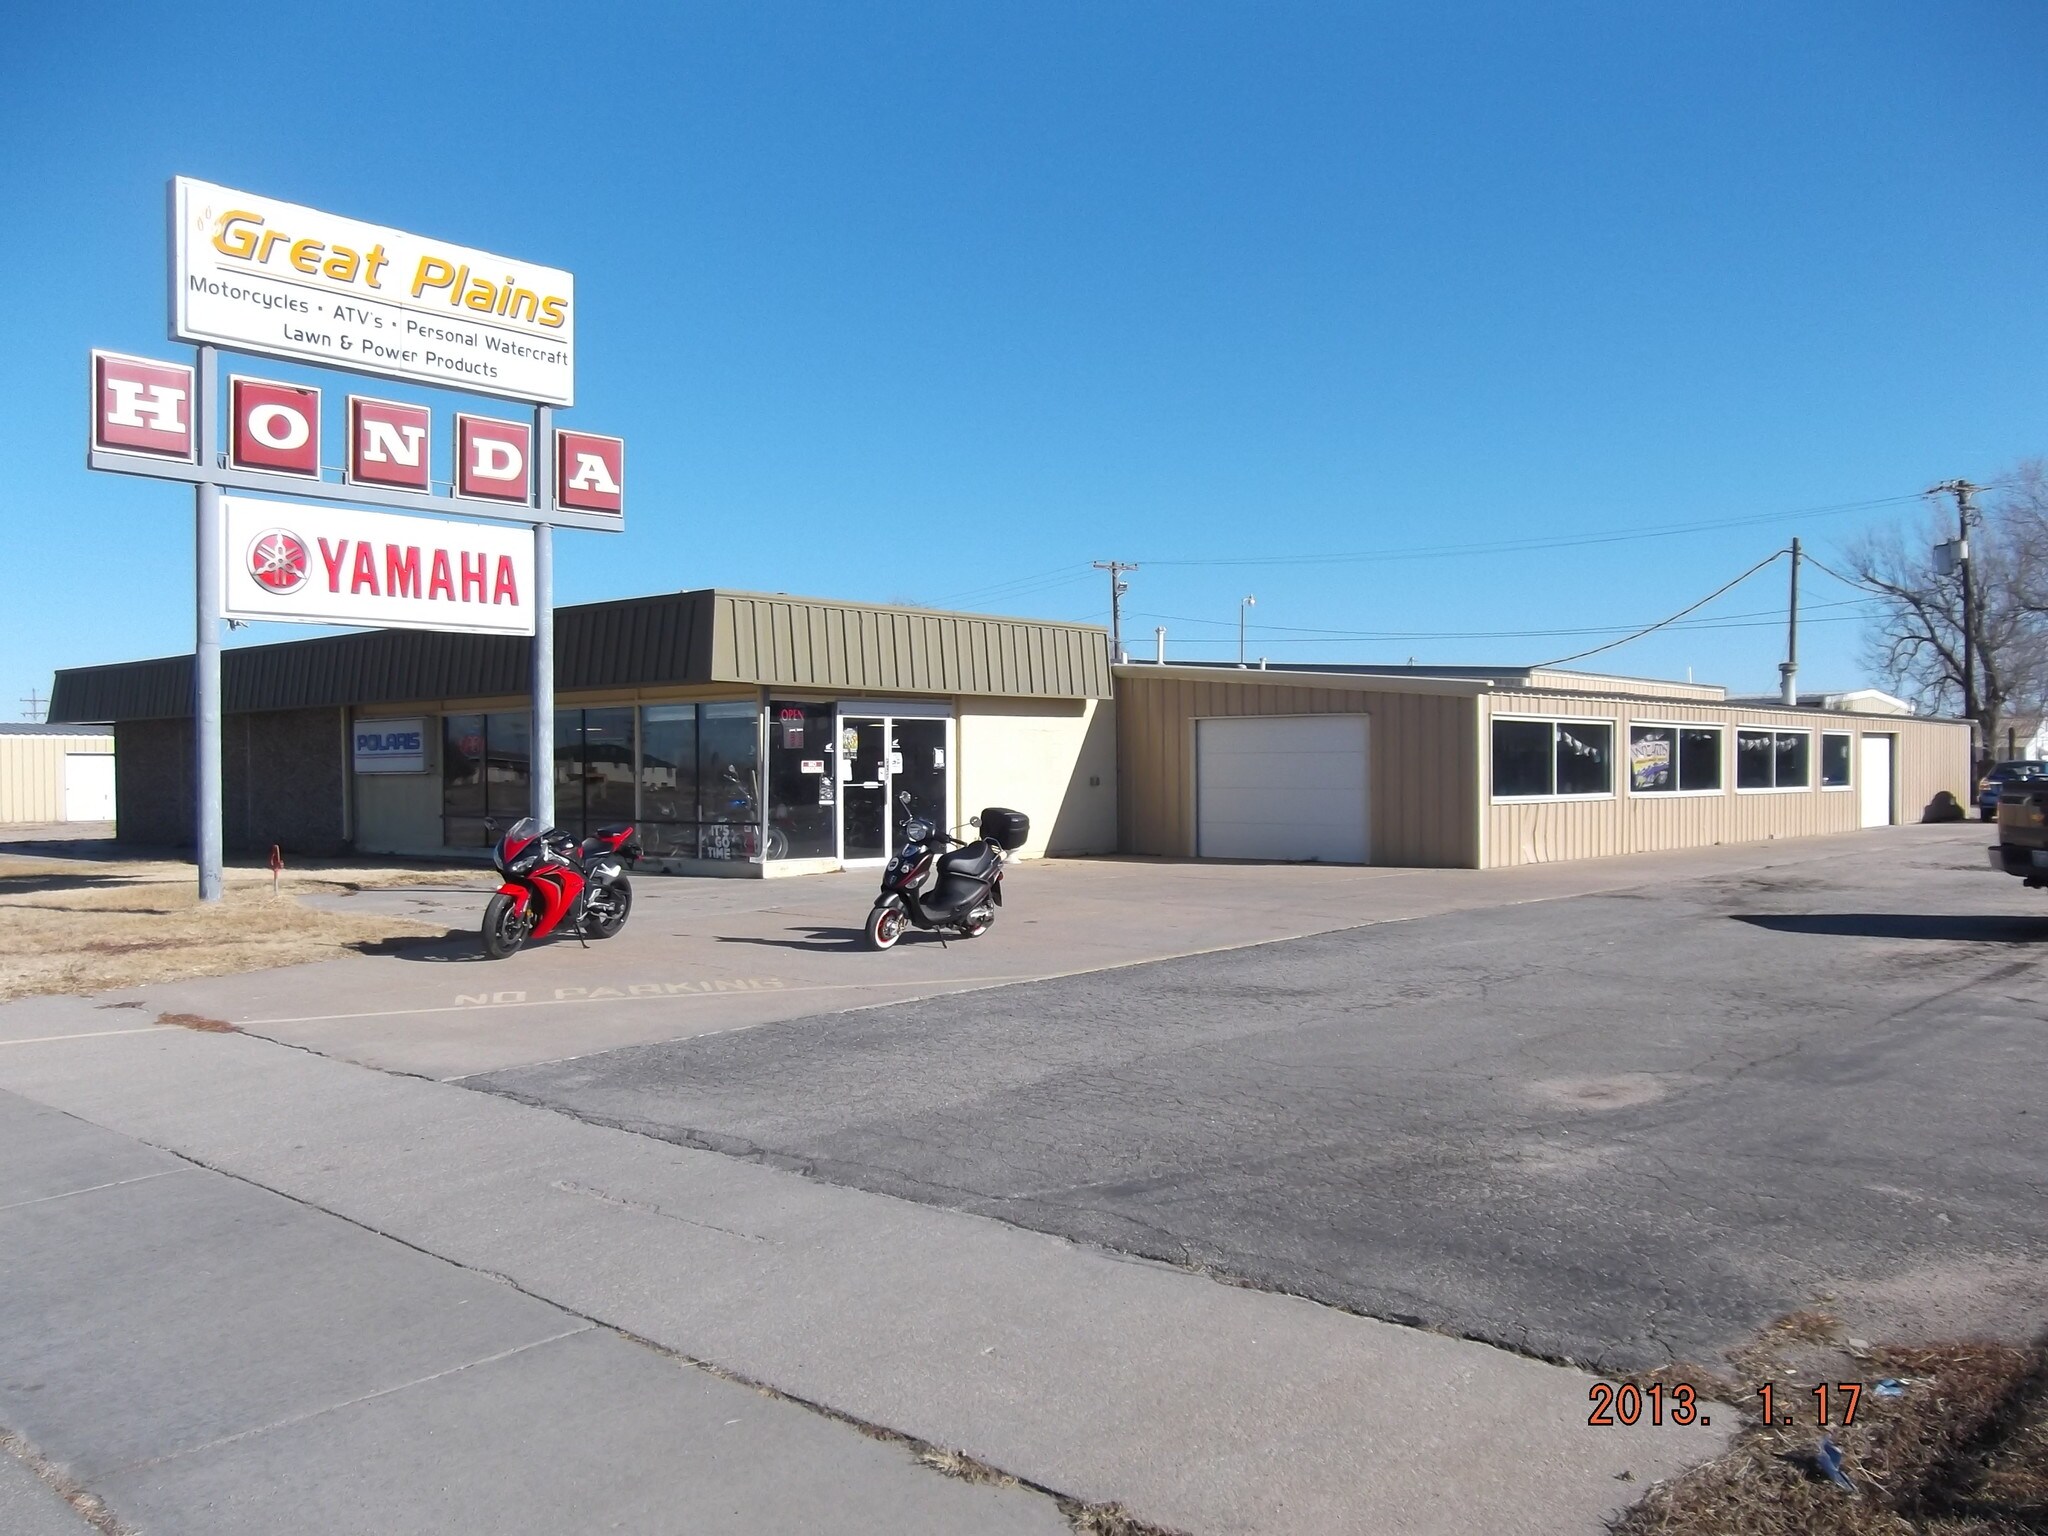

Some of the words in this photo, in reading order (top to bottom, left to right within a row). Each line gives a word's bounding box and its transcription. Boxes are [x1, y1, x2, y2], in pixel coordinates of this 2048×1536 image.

[211, 210, 389, 289] Great
[411, 256, 568, 328] Plains
[190, 275, 309, 313] Motorcycles
[333, 305, 384, 328] ATV's
[407, 320, 478, 347] Personal
[485, 335, 568, 366] Watercraft
[284, 323, 331, 346] Lawn
[340, 335, 353, 350] &
[362, 339, 417, 362] Power
[426, 351, 498, 378] Products
[107, 379, 620, 494] HONDA
[317, 537, 519, 606] YAMAHA
[781, 709, 805, 720] OPEN
[357, 732, 420, 751] POLARIS
[711, 825, 729, 836] IT'S
[715, 836, 730, 848] GO
[708, 847, 731, 859] TIME
[455, 991, 526, 1007] NO
[555, 978, 784, 1000] PARKING
